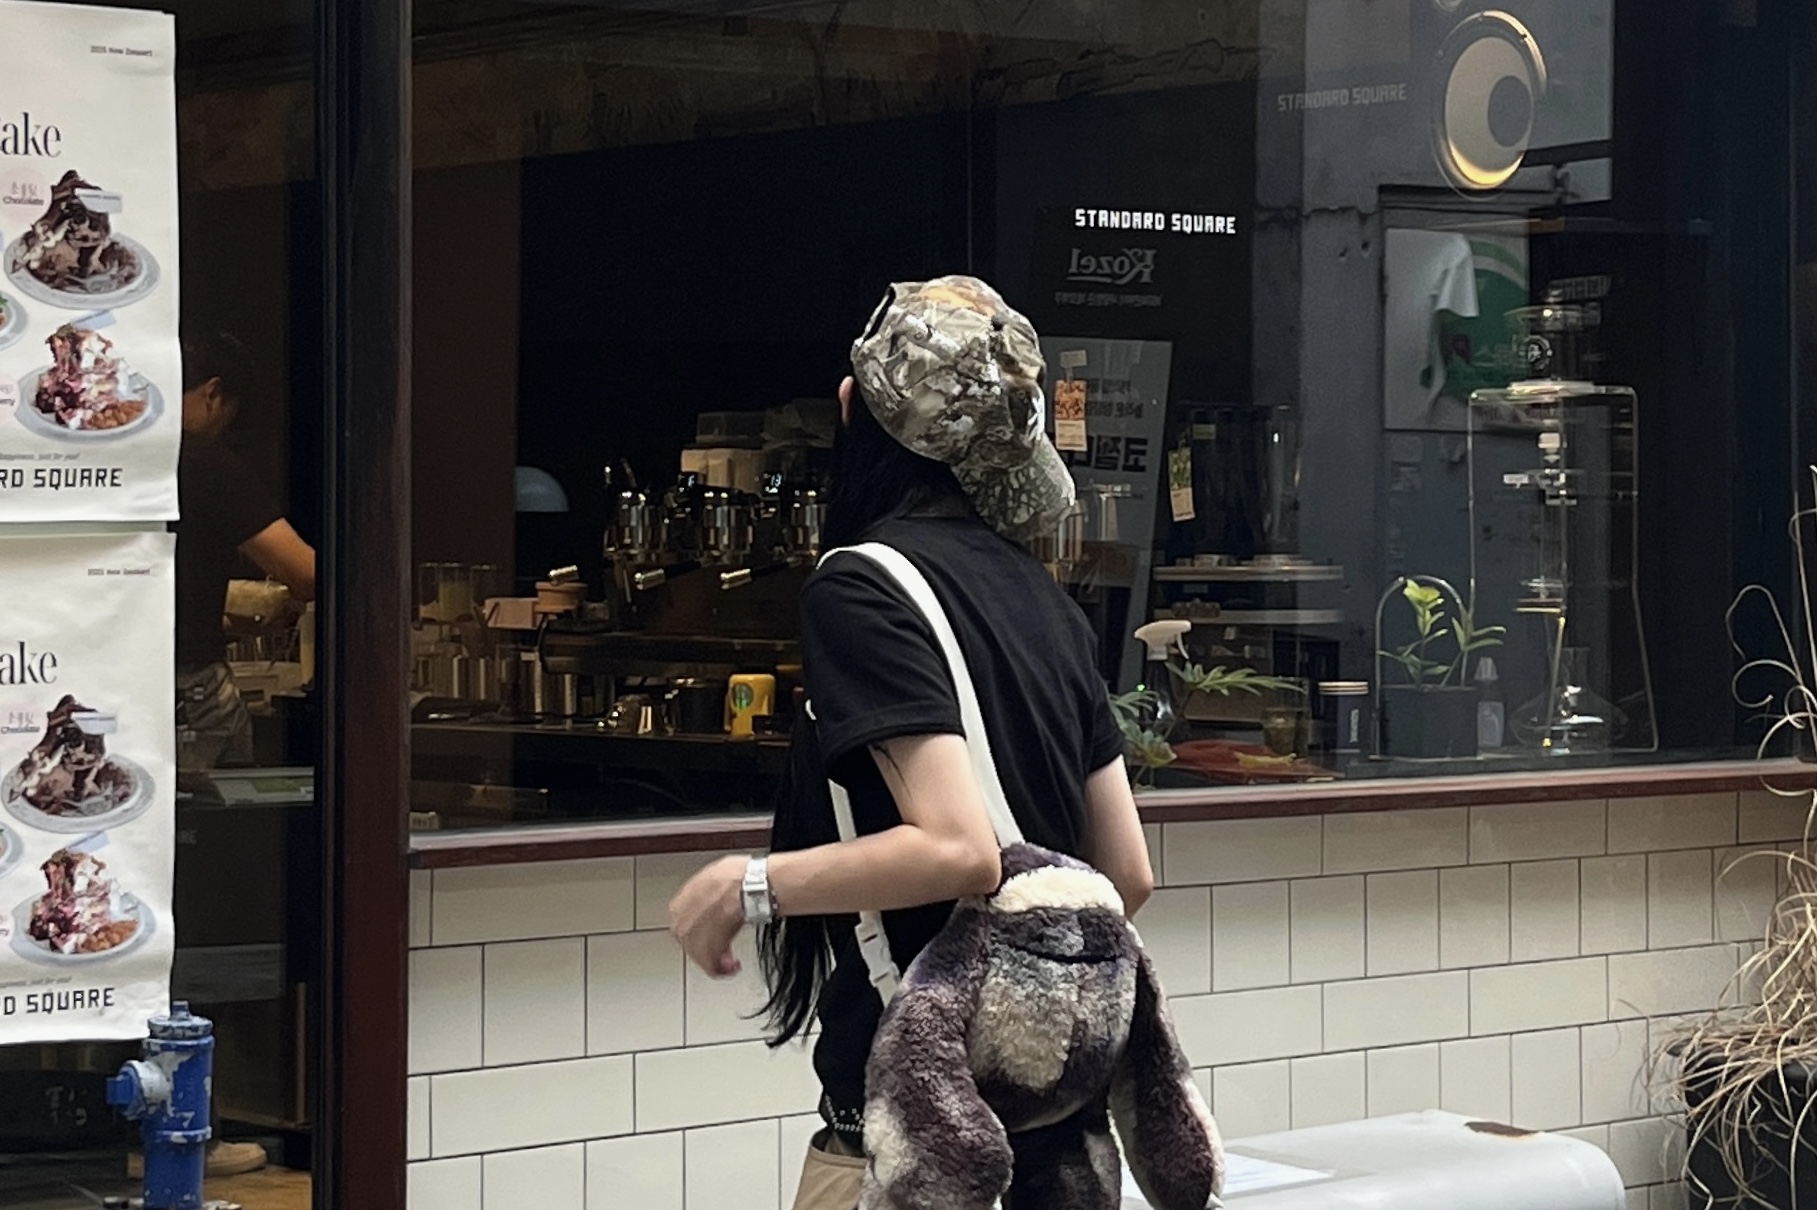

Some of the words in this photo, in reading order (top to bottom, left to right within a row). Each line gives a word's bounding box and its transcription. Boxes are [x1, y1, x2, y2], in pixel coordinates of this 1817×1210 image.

[1278, 89, 1349, 111] STANDARD
[1352, 83, 1406, 106] SQUARE
[0, 112, 61, 158] ake
[1075, 208, 1165, 230] STANDARD
[1171, 213, 1236, 234] SQUARE
[33, 468, 122, 490] SQUARE
[0, 996, 15, 1015] D
[27, 987, 115, 1014] SQUARE
